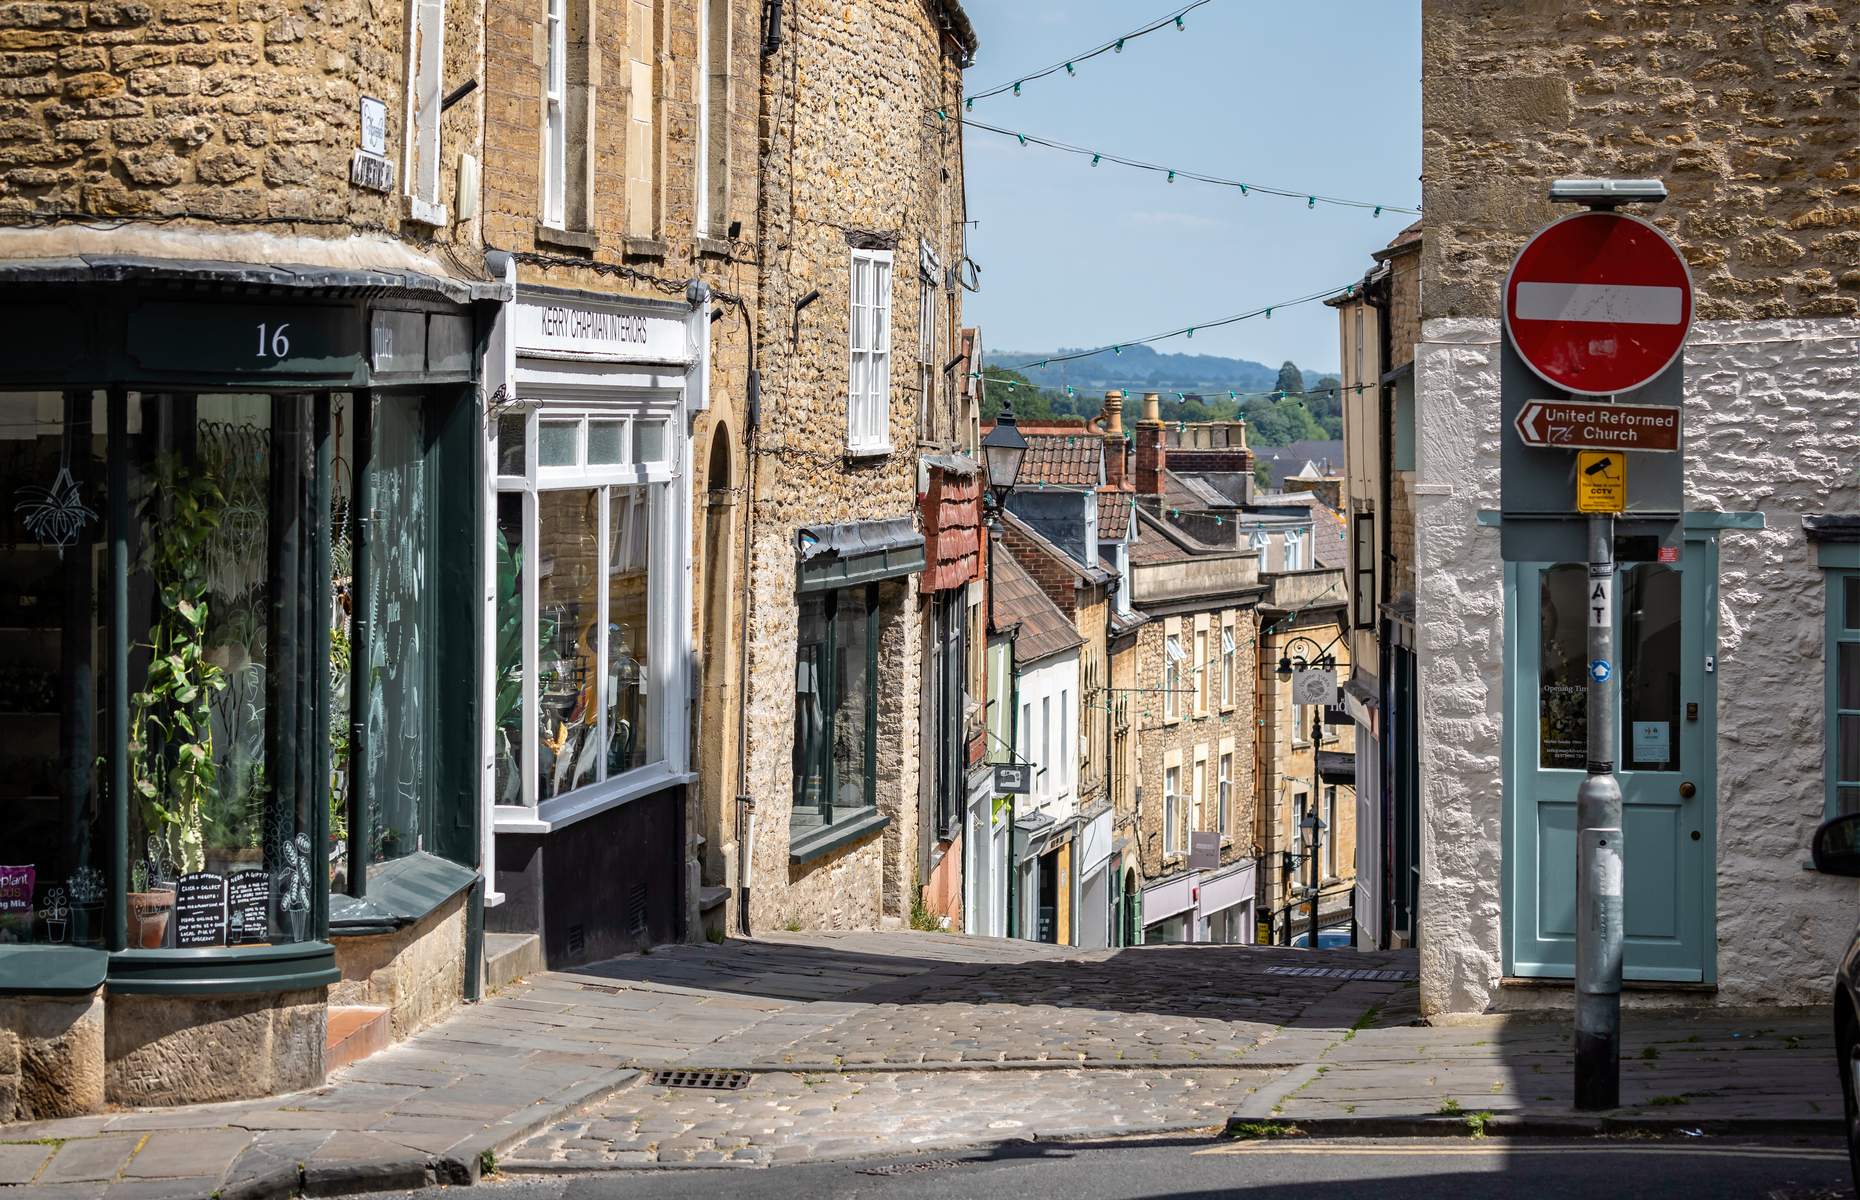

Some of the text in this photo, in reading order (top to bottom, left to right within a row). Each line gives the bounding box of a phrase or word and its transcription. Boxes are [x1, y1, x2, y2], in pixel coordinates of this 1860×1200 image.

[542, 306, 647, 344] KERRY CHAPMAN INTERIORS
[256, 322, 291, 358] 16
[1545, 408, 1674, 427] United Reformed
[1583, 426, 1638, 441] Church
[1543, 684, 1589, 693] Opening Tim
[230, 873, 244, 883] NEED
